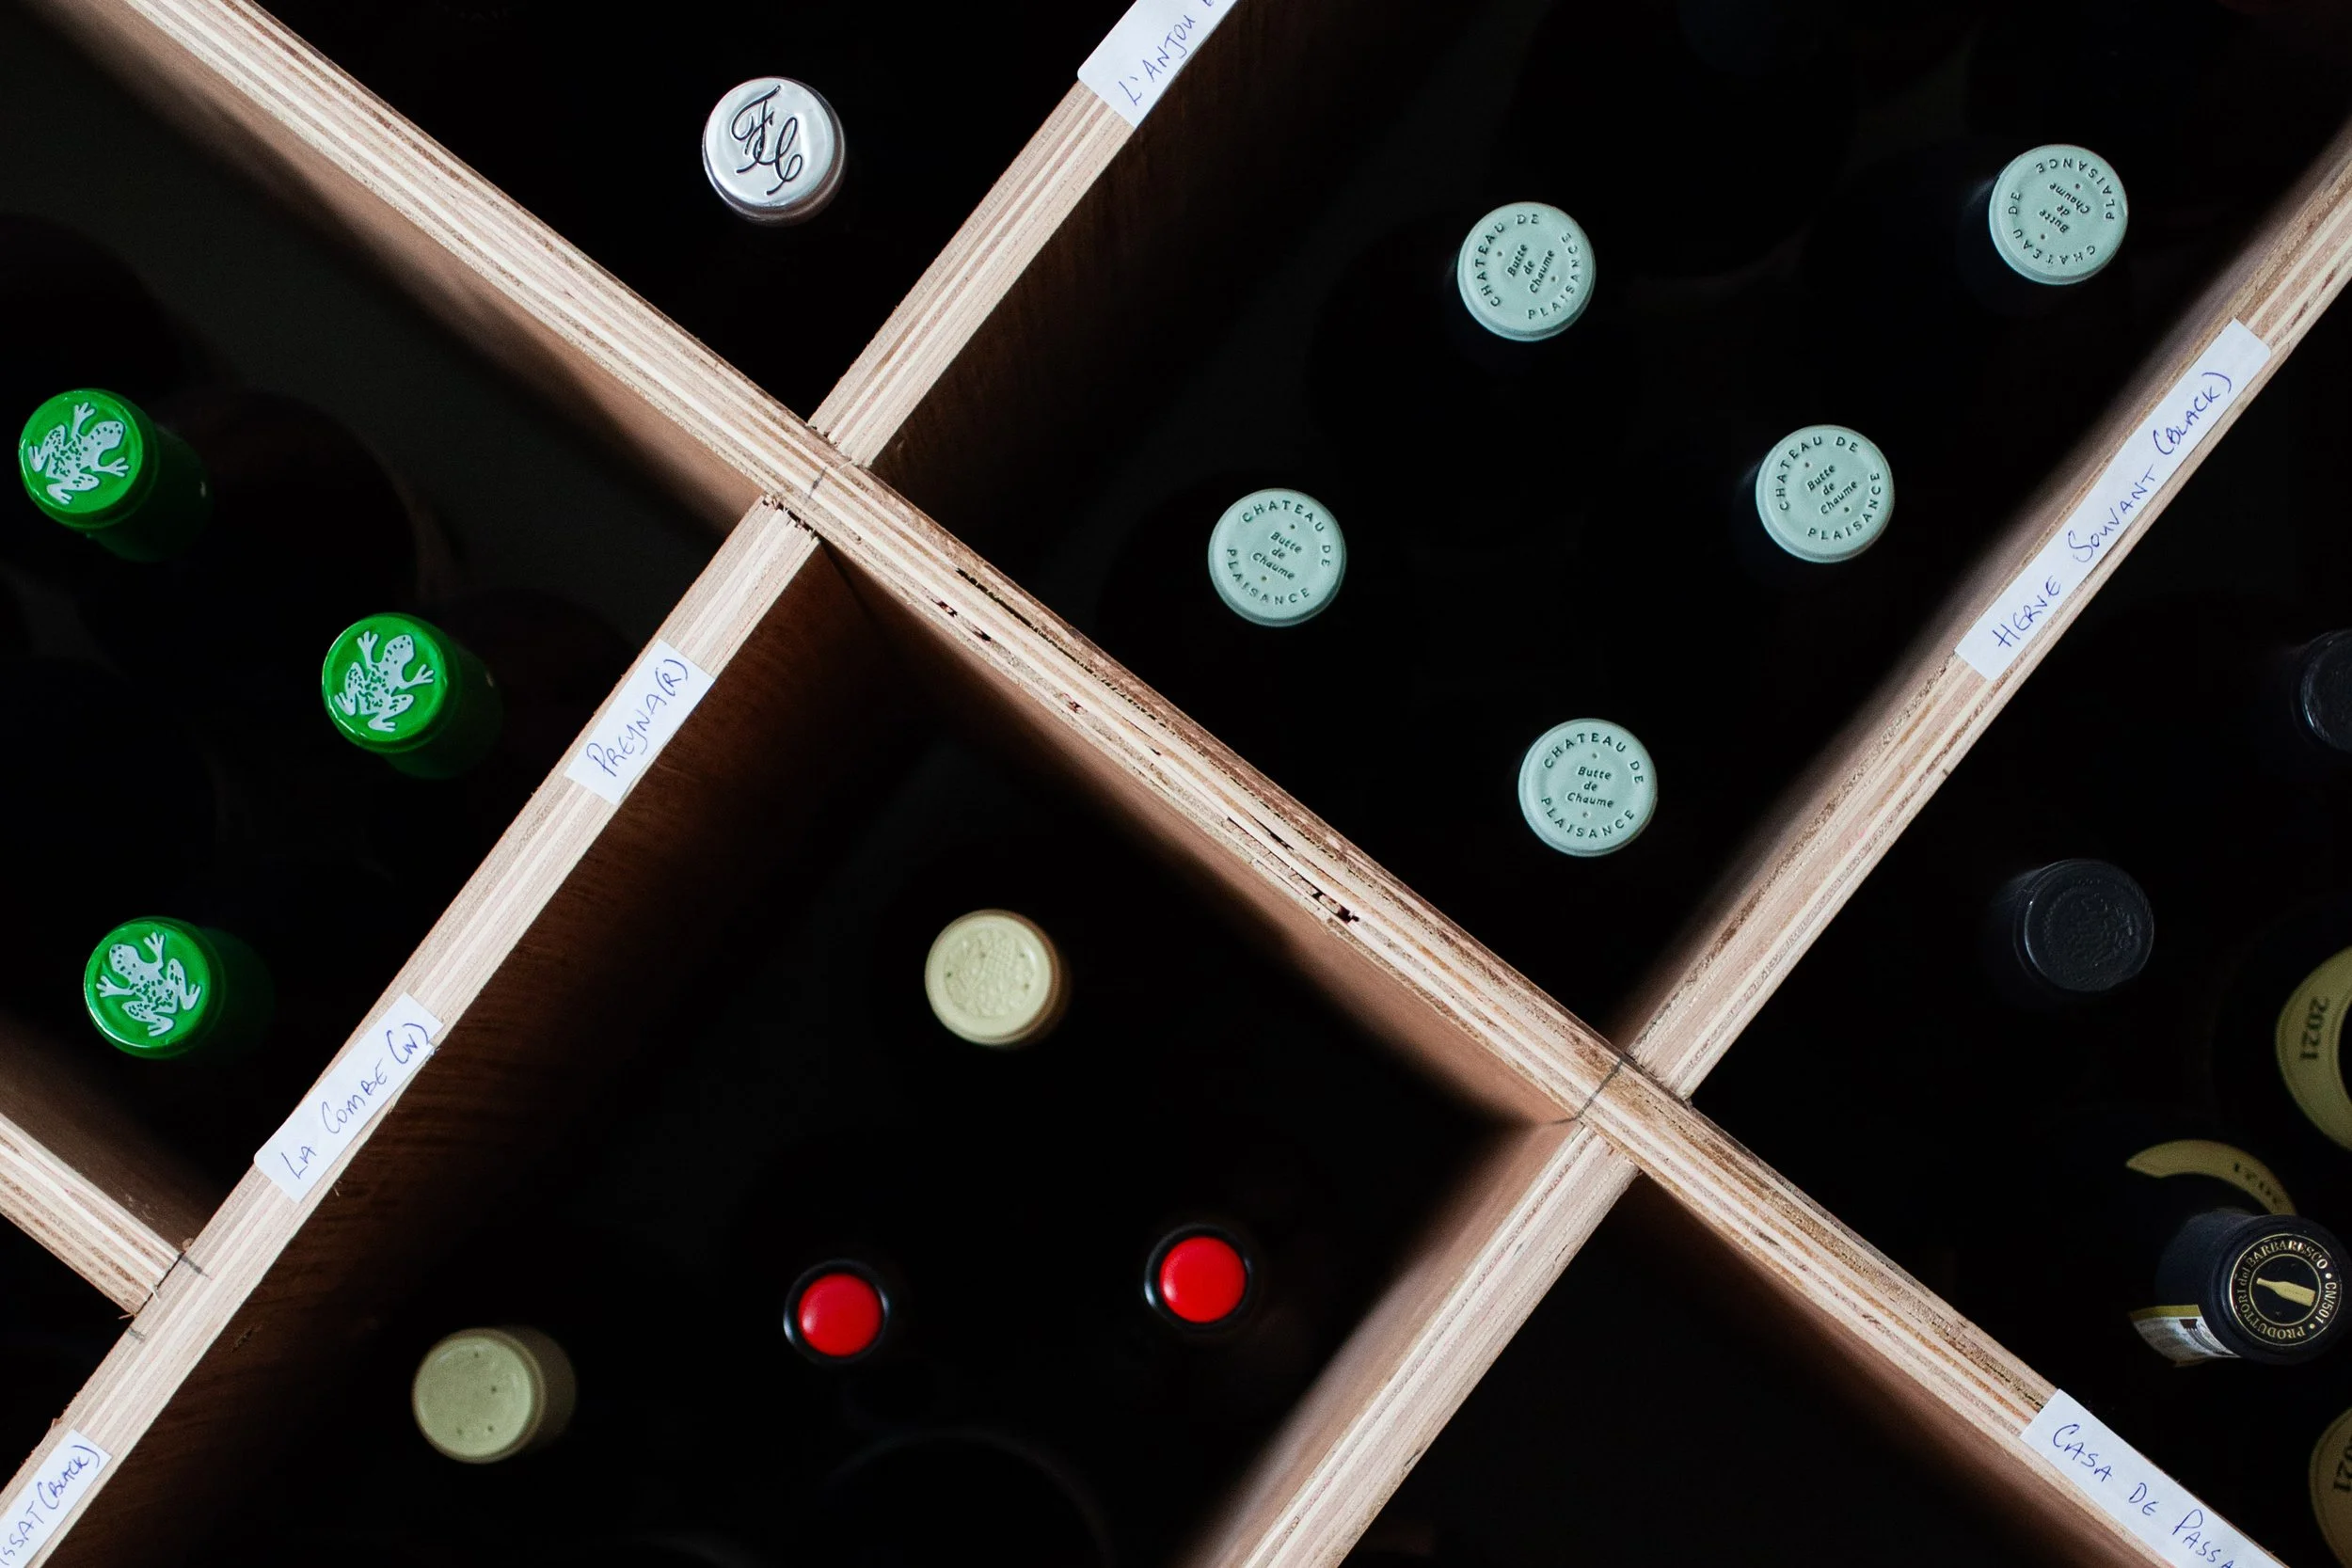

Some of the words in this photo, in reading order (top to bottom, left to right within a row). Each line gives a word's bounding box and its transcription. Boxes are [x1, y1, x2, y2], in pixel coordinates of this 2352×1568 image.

[2008, 192, 2022, 215] DE
[2035, 158, 2116, 221] PLAISANCE
[2049, 182, 2090, 214] Chaume
[2039, 209, 2070, 233] Butte
[2057, 205, 2070, 216] de
[1475, 223, 1504, 308] CHATEAU
[1517, 214, 1539, 225] DE
[1507, 244, 1529, 277] Butte
[2012, 229, 2096, 265] CHATEAU
[1524, 261, 1535, 275] de
[1528, 232, 1581, 320] PLAISANCE
[1530, 249, 1555, 293] Chaume
[1776, 436, 1822, 511] CHATEAU
[1836, 436, 1859, 451] DE
[1807, 464, 1836, 491] Butte
[1822, 483, 1836, 496] de
[1807, 472, 1882, 541] PLAISANCE
[1820, 481, 1858, 515] Chaume
[1992, 575, 2061, 648] HERVE
[2153, 372, 2233, 455] (BLACK)
[1242, 499, 1325, 532] CHATEAU
[1321, 545, 1331, 566] DE
[1271, 531, 1303, 553] Butte
[1252, 552, 1295, 580] Chaume
[1271, 548, 1286, 560] de
[1227, 548, 1310, 605] PLAISANCE
[1544, 733, 1627, 769] CHATEAU
[1629, 760, 1644, 784] DE
[1578, 767, 1613, 780] Butte
[1566, 792, 1614, 808] Chaume
[1583, 781, 1598, 792] de
[1541, 798, 1635, 839] PLAISANCE
[280, 1145, 317, 1180] LA
[322, 1057, 388, 1134] COMBE
[2245, 1240, 2328, 1271] BARBARESCO
[2236, 1289, 2307, 1340] PRODUTTORI
[2315, 1281, 2337, 1324] CN/501
[2053, 1422, 2112, 1482] CASA
[2128, 1482, 2160, 1516] DE
[0, 1500, 45, 1566] SSAT
